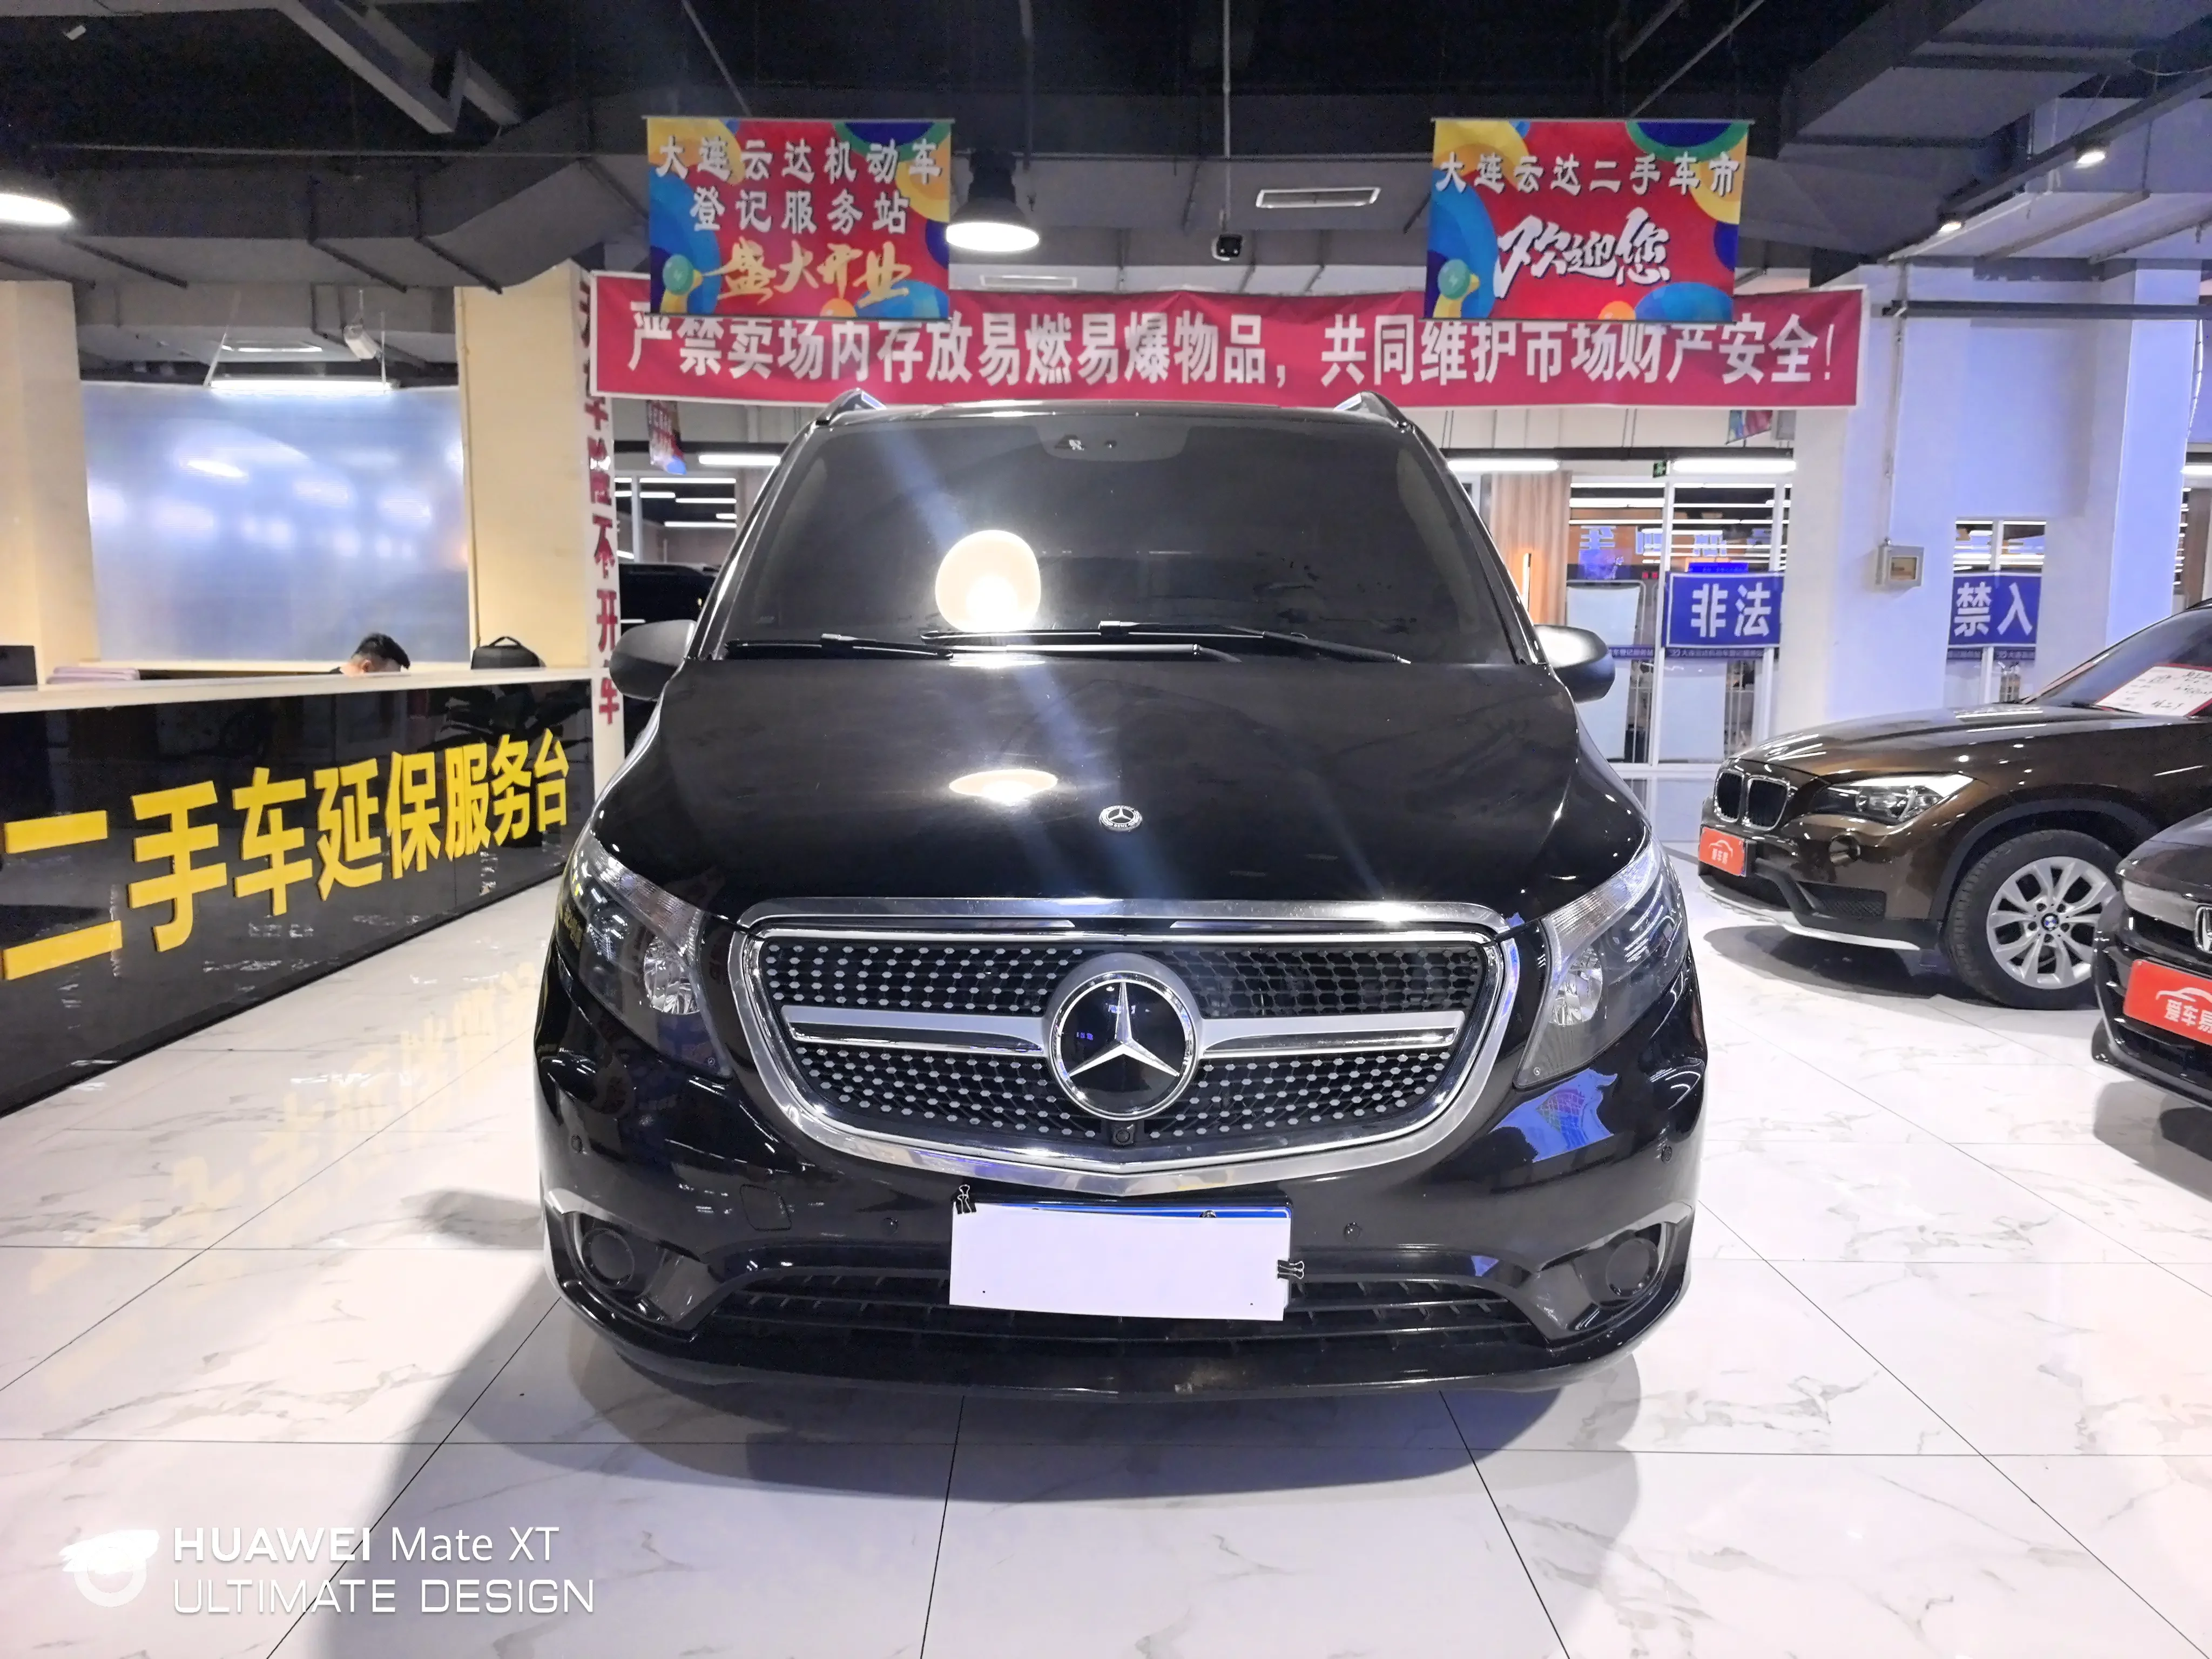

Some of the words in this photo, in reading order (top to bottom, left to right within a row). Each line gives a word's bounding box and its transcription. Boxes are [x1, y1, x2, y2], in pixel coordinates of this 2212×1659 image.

[655, 135, 942, 185] 大连云达机动车
[1435, 150, 1741, 197] 大连云达二手车市
[690, 186, 911, 234] 登记服务站
[704, 236, 914, 309] 盛大开业
[1494, 206, 1671, 299] 欢迎您
[1690, 582, 1771, 638] 非法
[1953, 581, 2033, 637] 禁入
[2, 727, 569, 981] 二手车延保服务台
